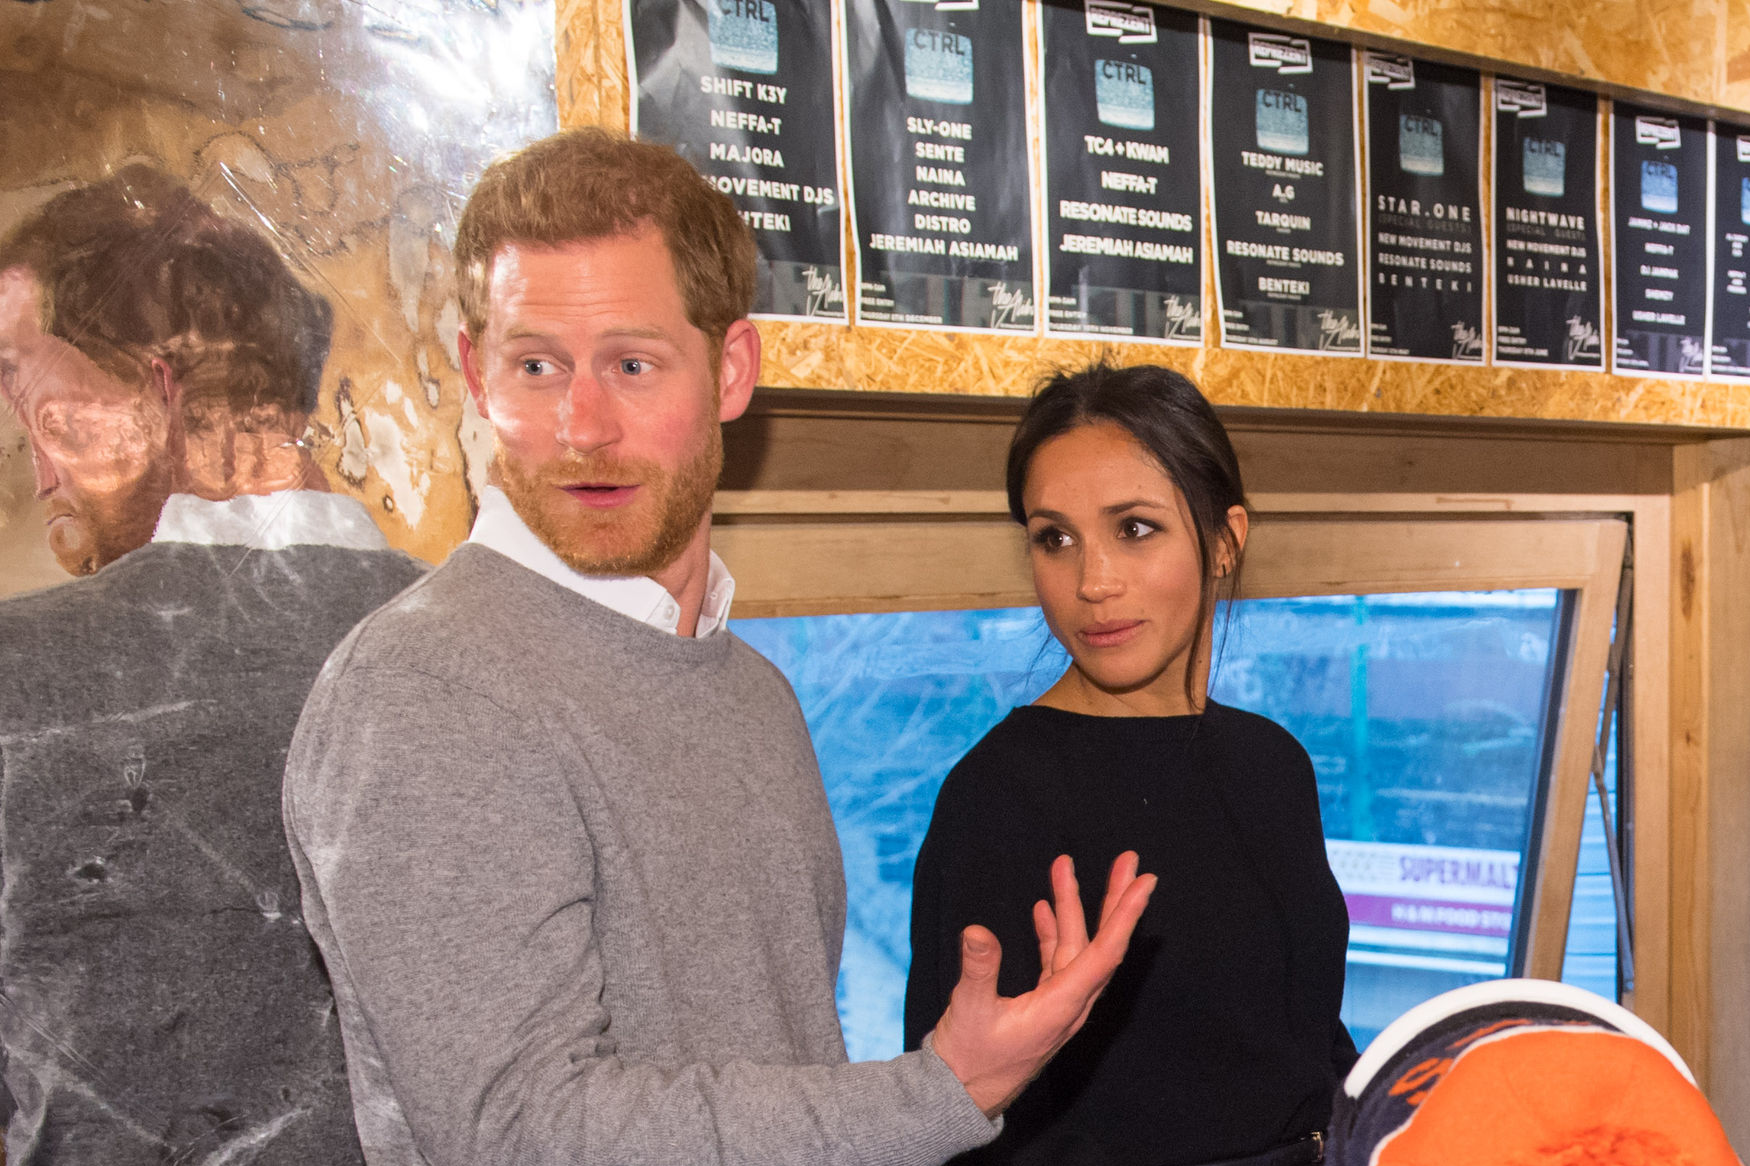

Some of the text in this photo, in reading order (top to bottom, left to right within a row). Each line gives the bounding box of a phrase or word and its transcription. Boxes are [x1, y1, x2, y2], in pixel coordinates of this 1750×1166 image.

[914, 31, 965, 56] CTRL
[1102, 61, 1146, 85] CTRL
[701, 76, 787, 104] SHIFT K3Y
[1263, 90, 1302, 113] CTRL
[711, 110, 782, 136] NEFFA-T
[907, 116, 972, 140] SLY-ONE
[1405, 117, 1438, 137] CTRL
[709, 143, 785, 168] MAJORA
[915, 142, 965, 163] SENTE
[1084, 135, 1114, 156] TC4
[1126, 141, 1170, 164] KWAM
[916, 165, 966, 186] NAINA
[1241, 151, 1282, 169] TEDDY
[1285, 158, 1324, 176] MUSIC
[1101, 171, 1158, 195] NEFFA-T
[803, 186, 835, 205] DJS
[908, 189, 976, 211] ARCHIVE
[914, 214, 971, 234] DISTRO
[1060, 200, 1192, 232] RESONATE SOUNDS
[1255, 210, 1311, 231] TARQUIN
[1506, 206, 1585, 231] NIGHTWAVE
[869, 233, 1018, 261] JEREMIAH ASIAMAH
[1059, 234, 1193, 264] JEREMIAH ASIAMAH
[1226, 240, 1290, 261] RESONATE
[1292, 248, 1344, 267] SOUNDS
[1398, 235, 1451, 251] MOVEMENT
[1379, 252, 1472, 274] RESONATE SOUNDS
[1258, 276, 1310, 295] BENTEKI
[1543, 277, 1587, 292] LAVELLE
